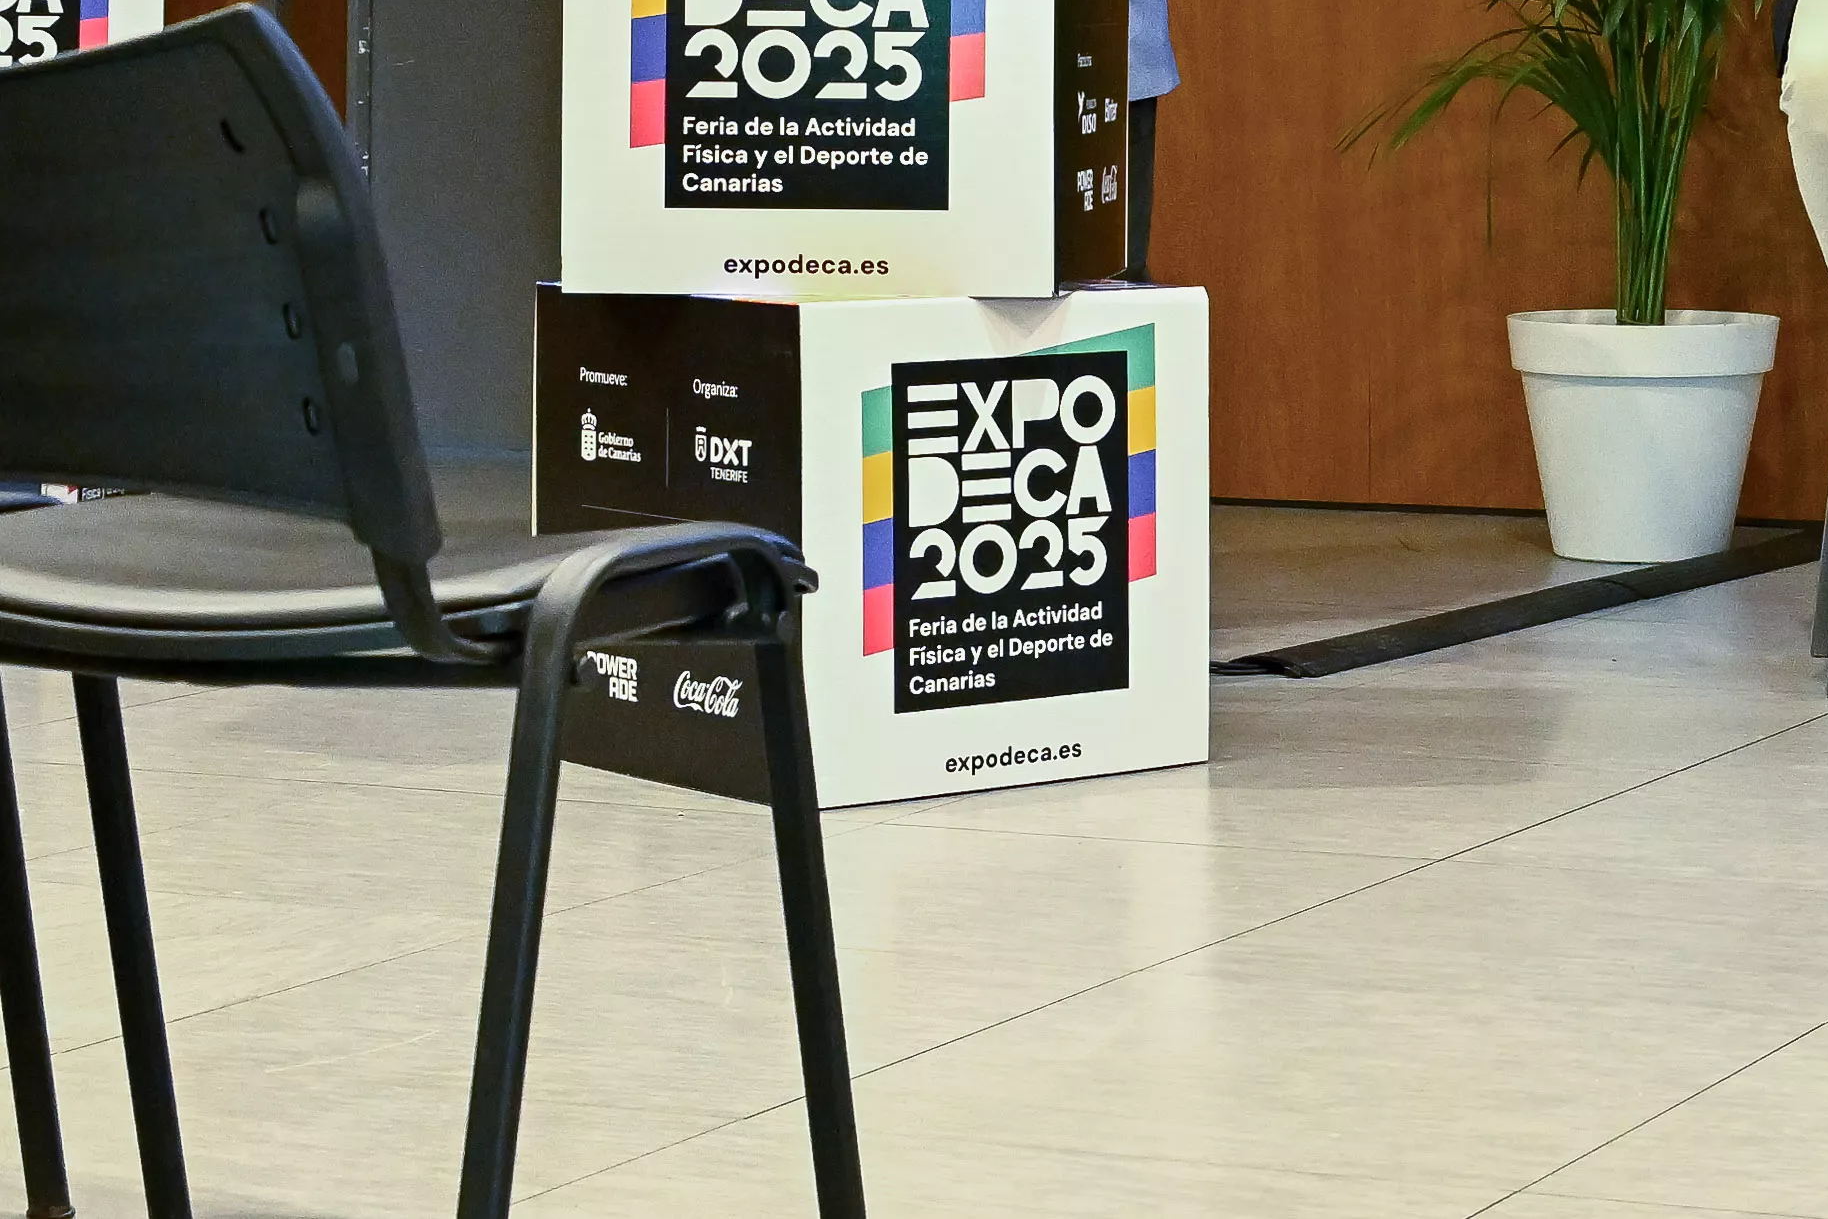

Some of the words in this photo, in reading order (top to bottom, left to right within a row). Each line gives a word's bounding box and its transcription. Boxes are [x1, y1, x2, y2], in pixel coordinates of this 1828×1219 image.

[685, 29, 925, 101] 2025
[683, 116, 738, 135] Feria
[745, 117, 773, 135] de
[780, 117, 798, 135] la
[805, 117, 915, 136] Actividad
[683, 144, 747, 164] Física
[754, 150, 768, 169] y
[774, 145, 793, 164] el
[801, 146, 893, 169] Deporte
[900, 146, 928, 165] de
[683, 173, 783, 192] Canarias
[724, 254, 888, 279] expodeca.es
[580, 367, 627, 386] Promueve:
[693, 379, 738, 399] Organiza:
[907, 375, 1116, 455] EXPO
[598, 431, 634, 448] Gobierno
[710, 437, 752, 466] DXT
[598, 445, 608, 458] de
[608, 447, 641, 462] Canarias
[710, 467, 747, 483] TENERIFE
[908, 445, 1112, 527] DECA
[910, 516, 1108, 600] 2025
[909, 616, 957, 637] Feria
[962, 613, 986, 632] de
[992, 611, 1007, 630] la
[1013, 601, 1102, 627] Actividad
[910, 645, 965, 666] Física
[971, 646, 982, 665] y
[988, 639, 1003, 658] el
[1009, 634, 1085, 658] Deporte
[1090, 629, 1113, 647] de
[609, 677, 638, 702] ADE
[910, 670, 995, 694] Canarias
[946, 743, 1081, 775] expodeca.es
